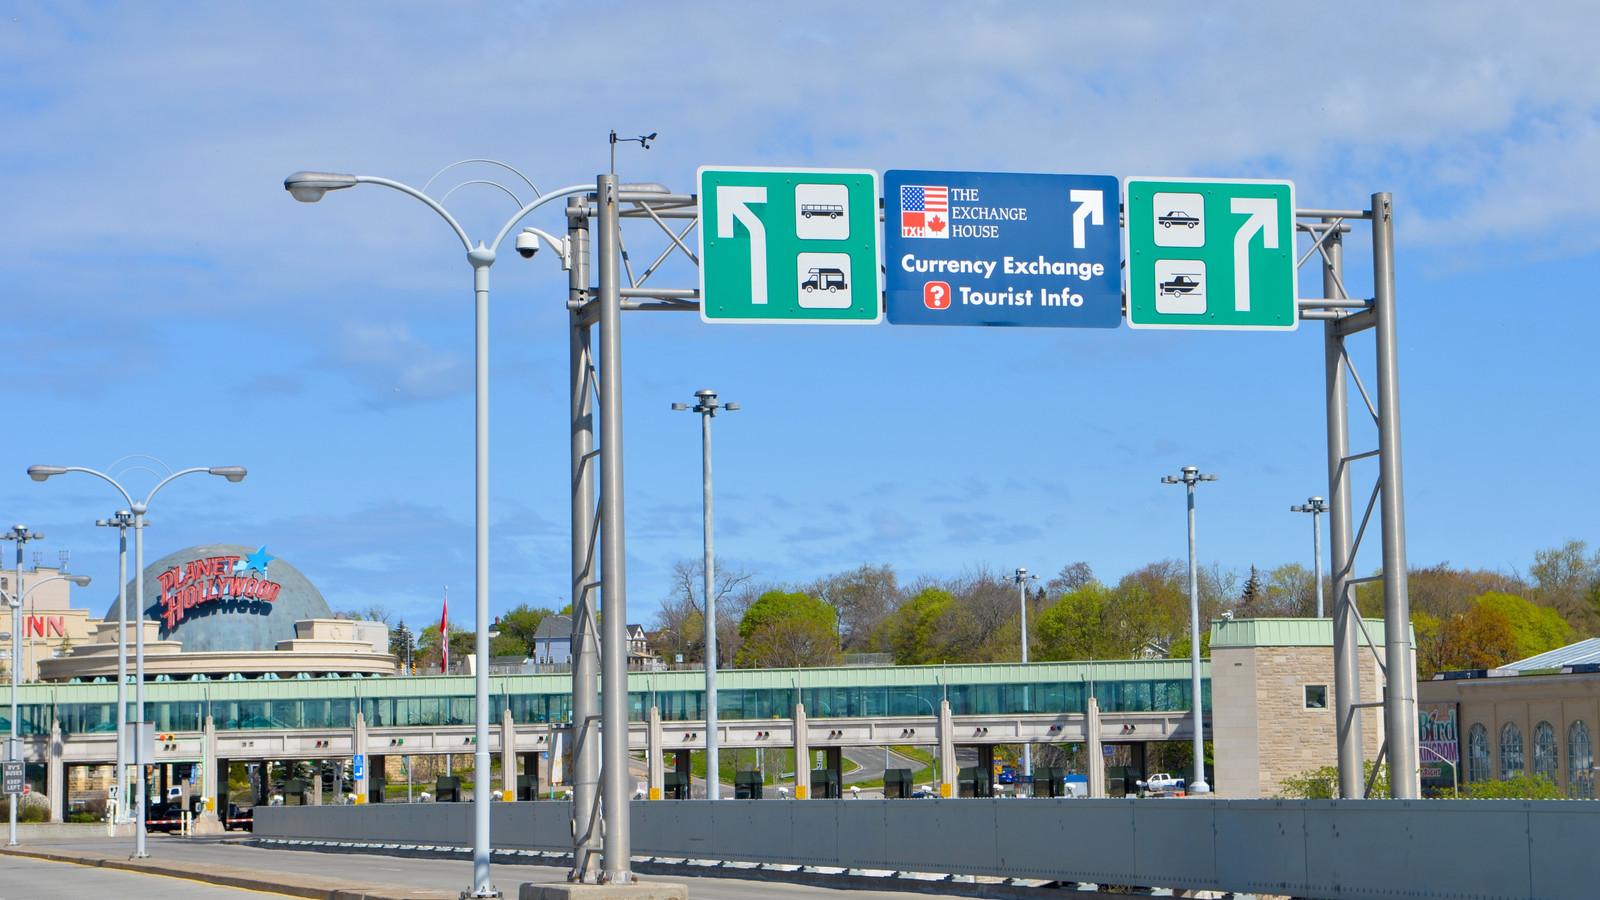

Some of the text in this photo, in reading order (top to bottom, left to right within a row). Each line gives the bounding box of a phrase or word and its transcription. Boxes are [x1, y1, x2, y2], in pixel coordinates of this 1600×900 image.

[951, 188, 979, 202] THE
[952, 207, 1027, 220] EXCHANGE
[903, 227, 925, 237] TXH
[952, 225, 999, 238] HOUSE
[901, 254, 1104, 280] Currency Exchange
[959, 286, 1033, 306] Tourist
[1041, 287, 1084, 307] Info
[157, 556, 240, 606] PLANET
[162, 577, 281, 629] HOLLYWOOD
